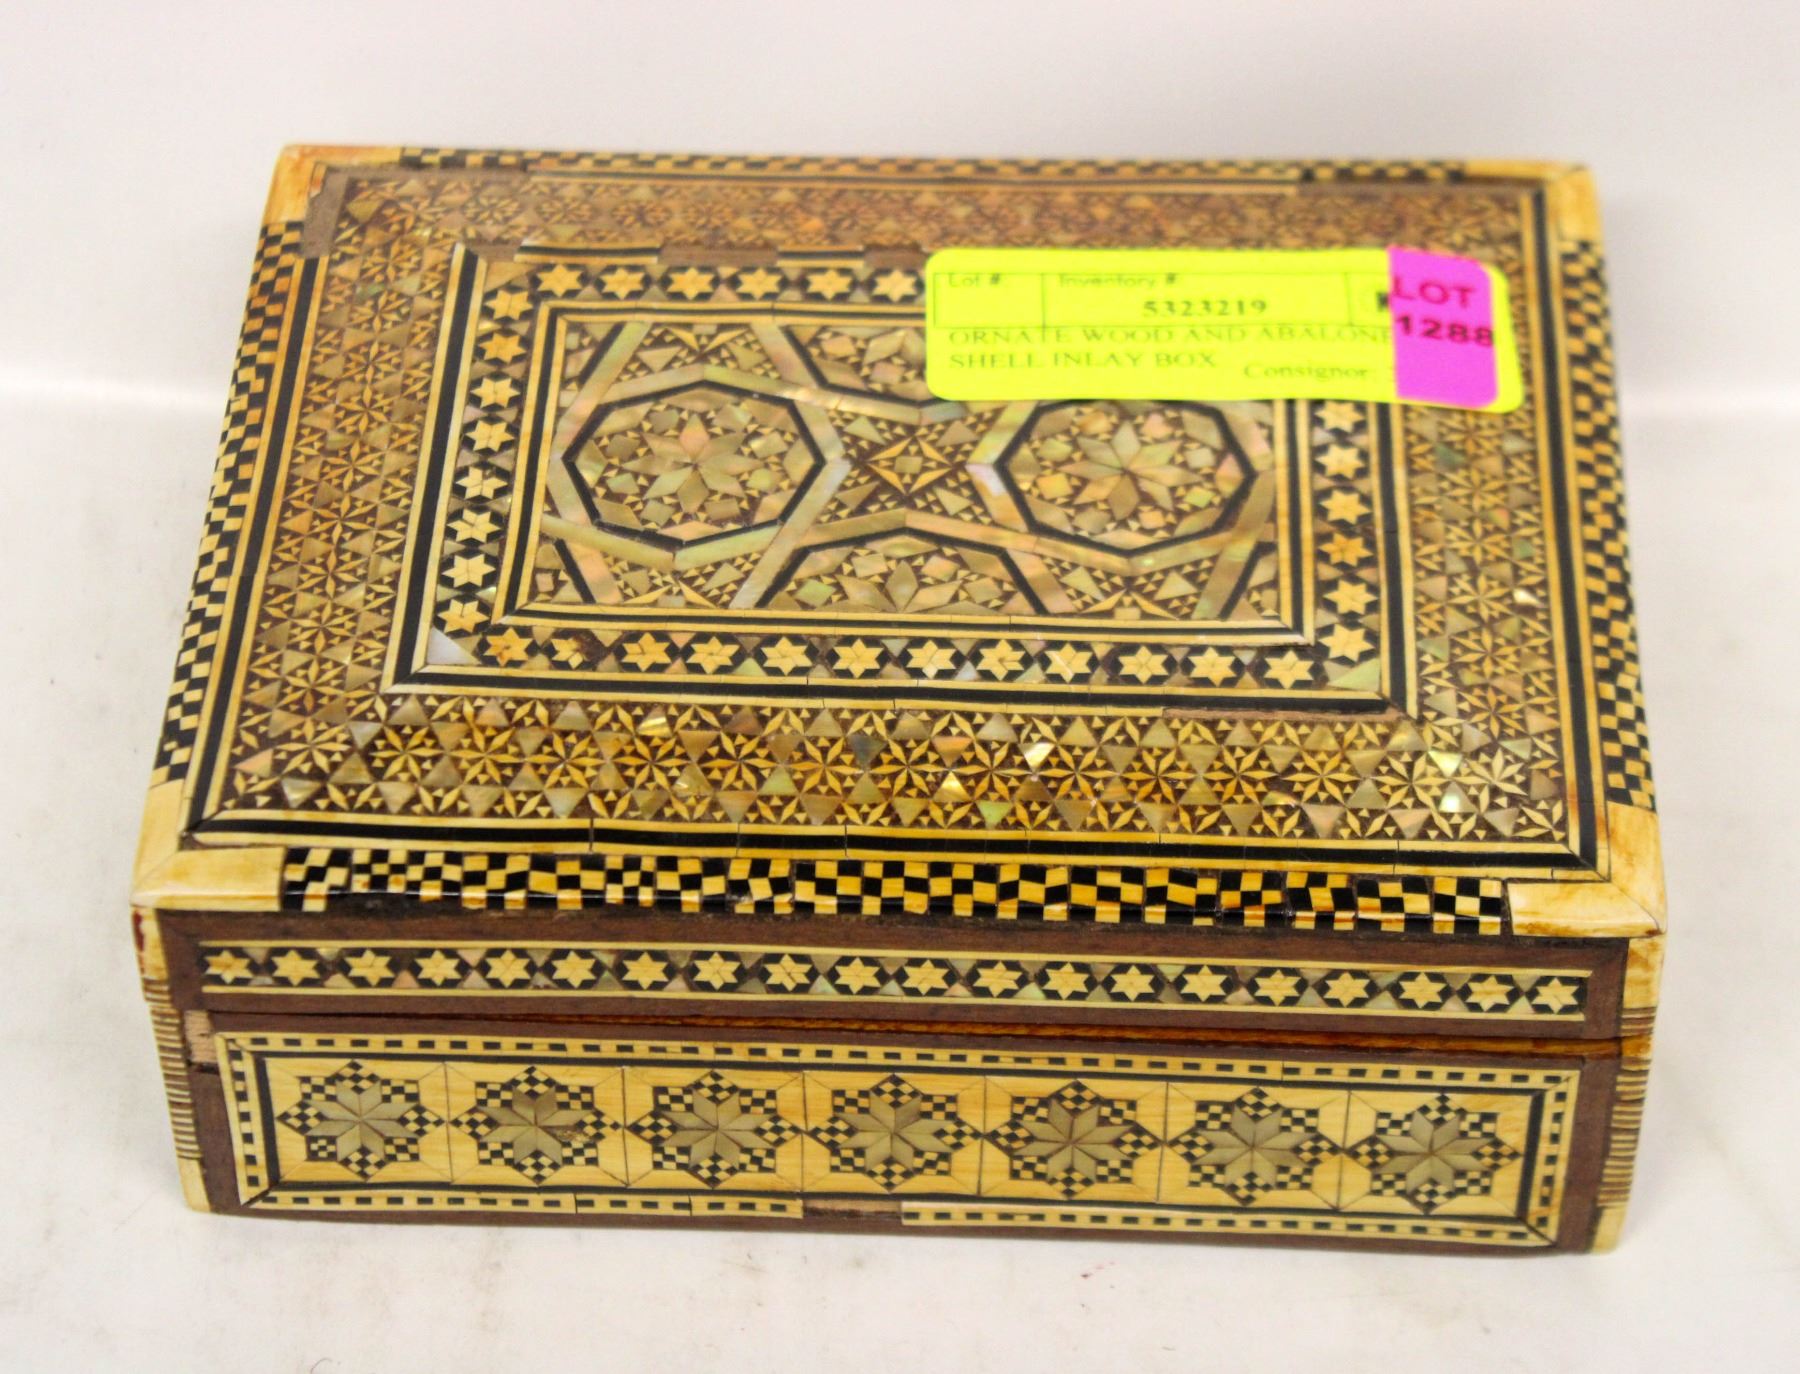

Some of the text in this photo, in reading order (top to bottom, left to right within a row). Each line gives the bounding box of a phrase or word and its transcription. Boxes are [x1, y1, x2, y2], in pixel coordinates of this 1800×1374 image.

[949, 273, 1001, 288] Lot #
[1058, 273, 1177, 289] Inventory #
[1392, 275, 1473, 308] LOT
[1142, 299, 1267, 317] 5323219
[949, 328, 1070, 345] ORNATE
[1082, 327, 1175, 344] WOOD
[1187, 327, 1246, 343] AND
[1396, 315, 1494, 348] 1288
[949, 352, 1217, 369] SHELL INLAY BOX
